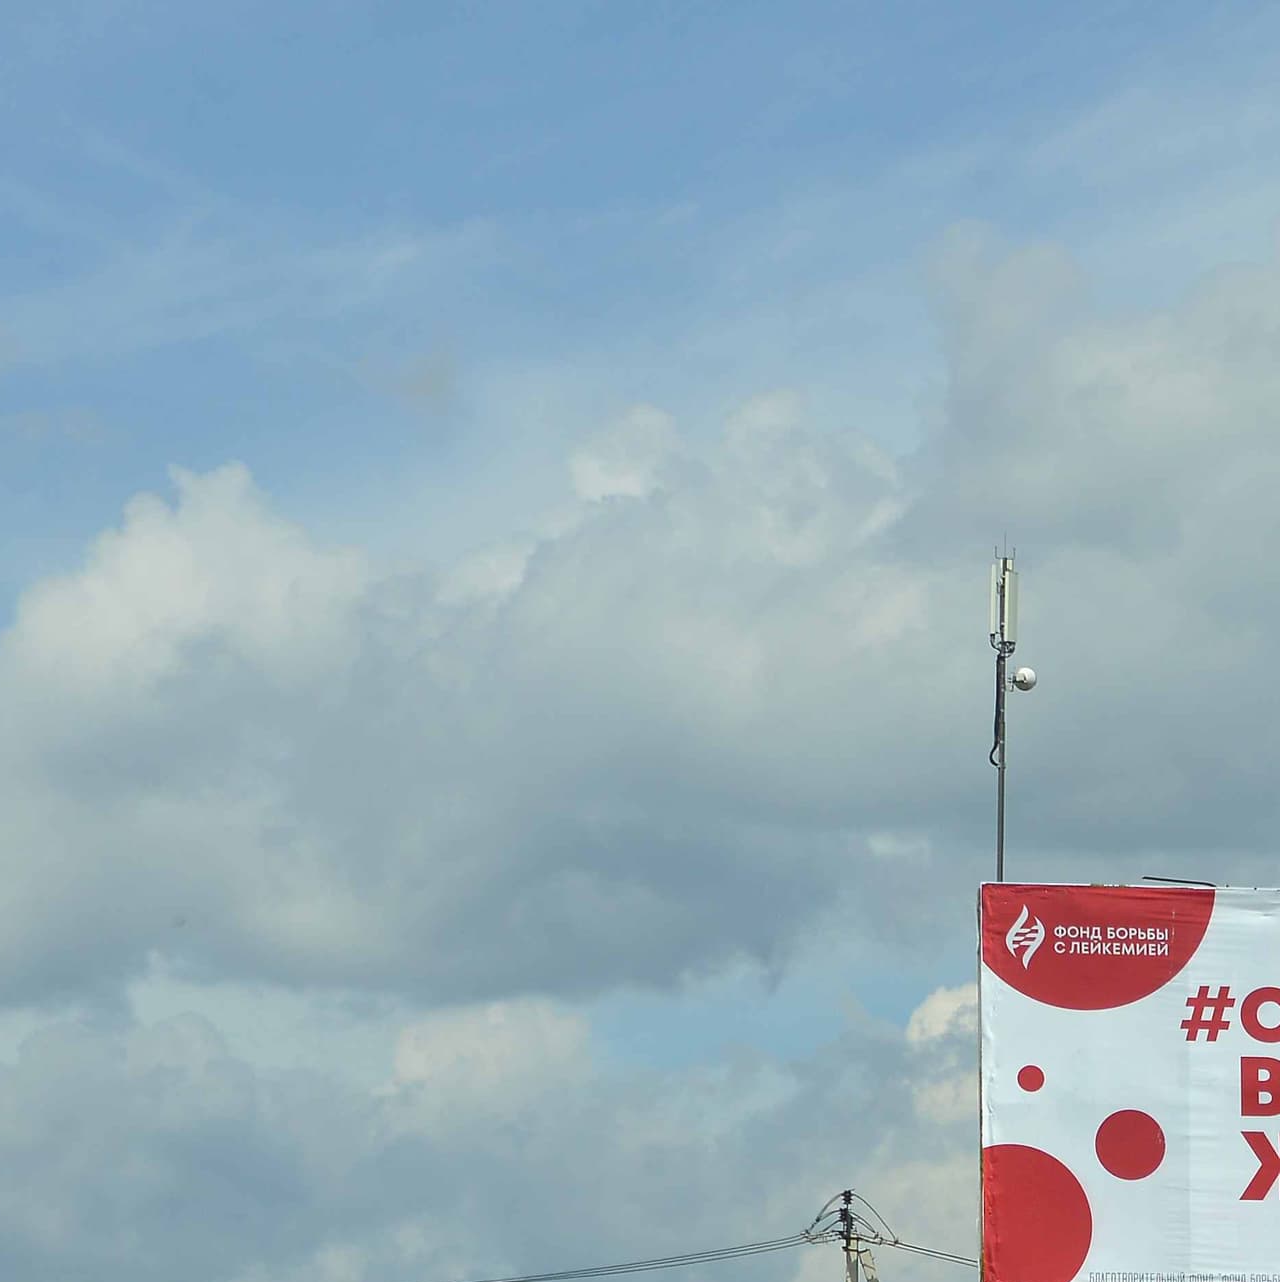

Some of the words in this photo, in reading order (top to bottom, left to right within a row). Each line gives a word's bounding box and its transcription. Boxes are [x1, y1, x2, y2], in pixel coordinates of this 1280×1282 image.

[1053, 925, 1102, 941] ФОНД
[1107, 927, 1169, 941] БОРЬБЫ
[1054, 941, 1066, 954] С
[1070, 940, 1169, 956] ЛЕЙКЕМИЕЙ
